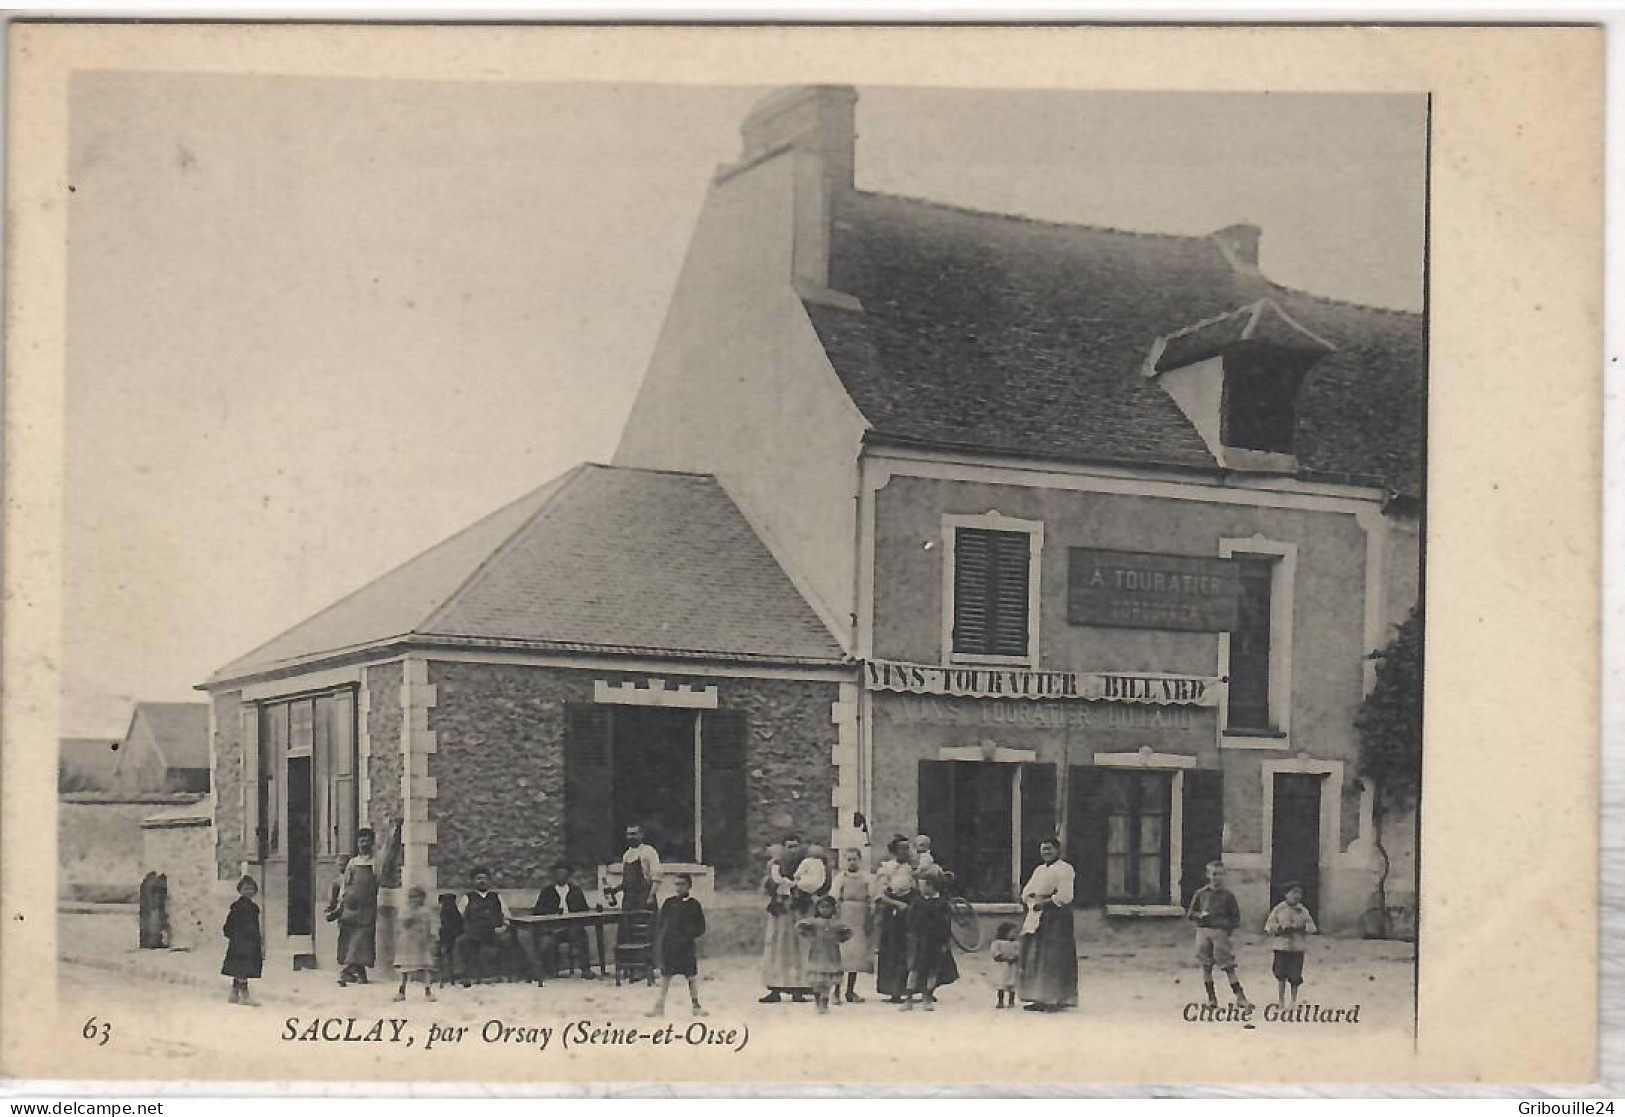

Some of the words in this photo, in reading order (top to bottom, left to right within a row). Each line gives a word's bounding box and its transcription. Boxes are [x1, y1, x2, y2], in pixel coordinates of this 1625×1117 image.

[1114, 570, 1221, 595] TOURATIER
[867, 661, 925, 688] VINS
[943, 667, 1077, 696] TOURATIER
[1102, 674, 1206, 702] BILLARD
